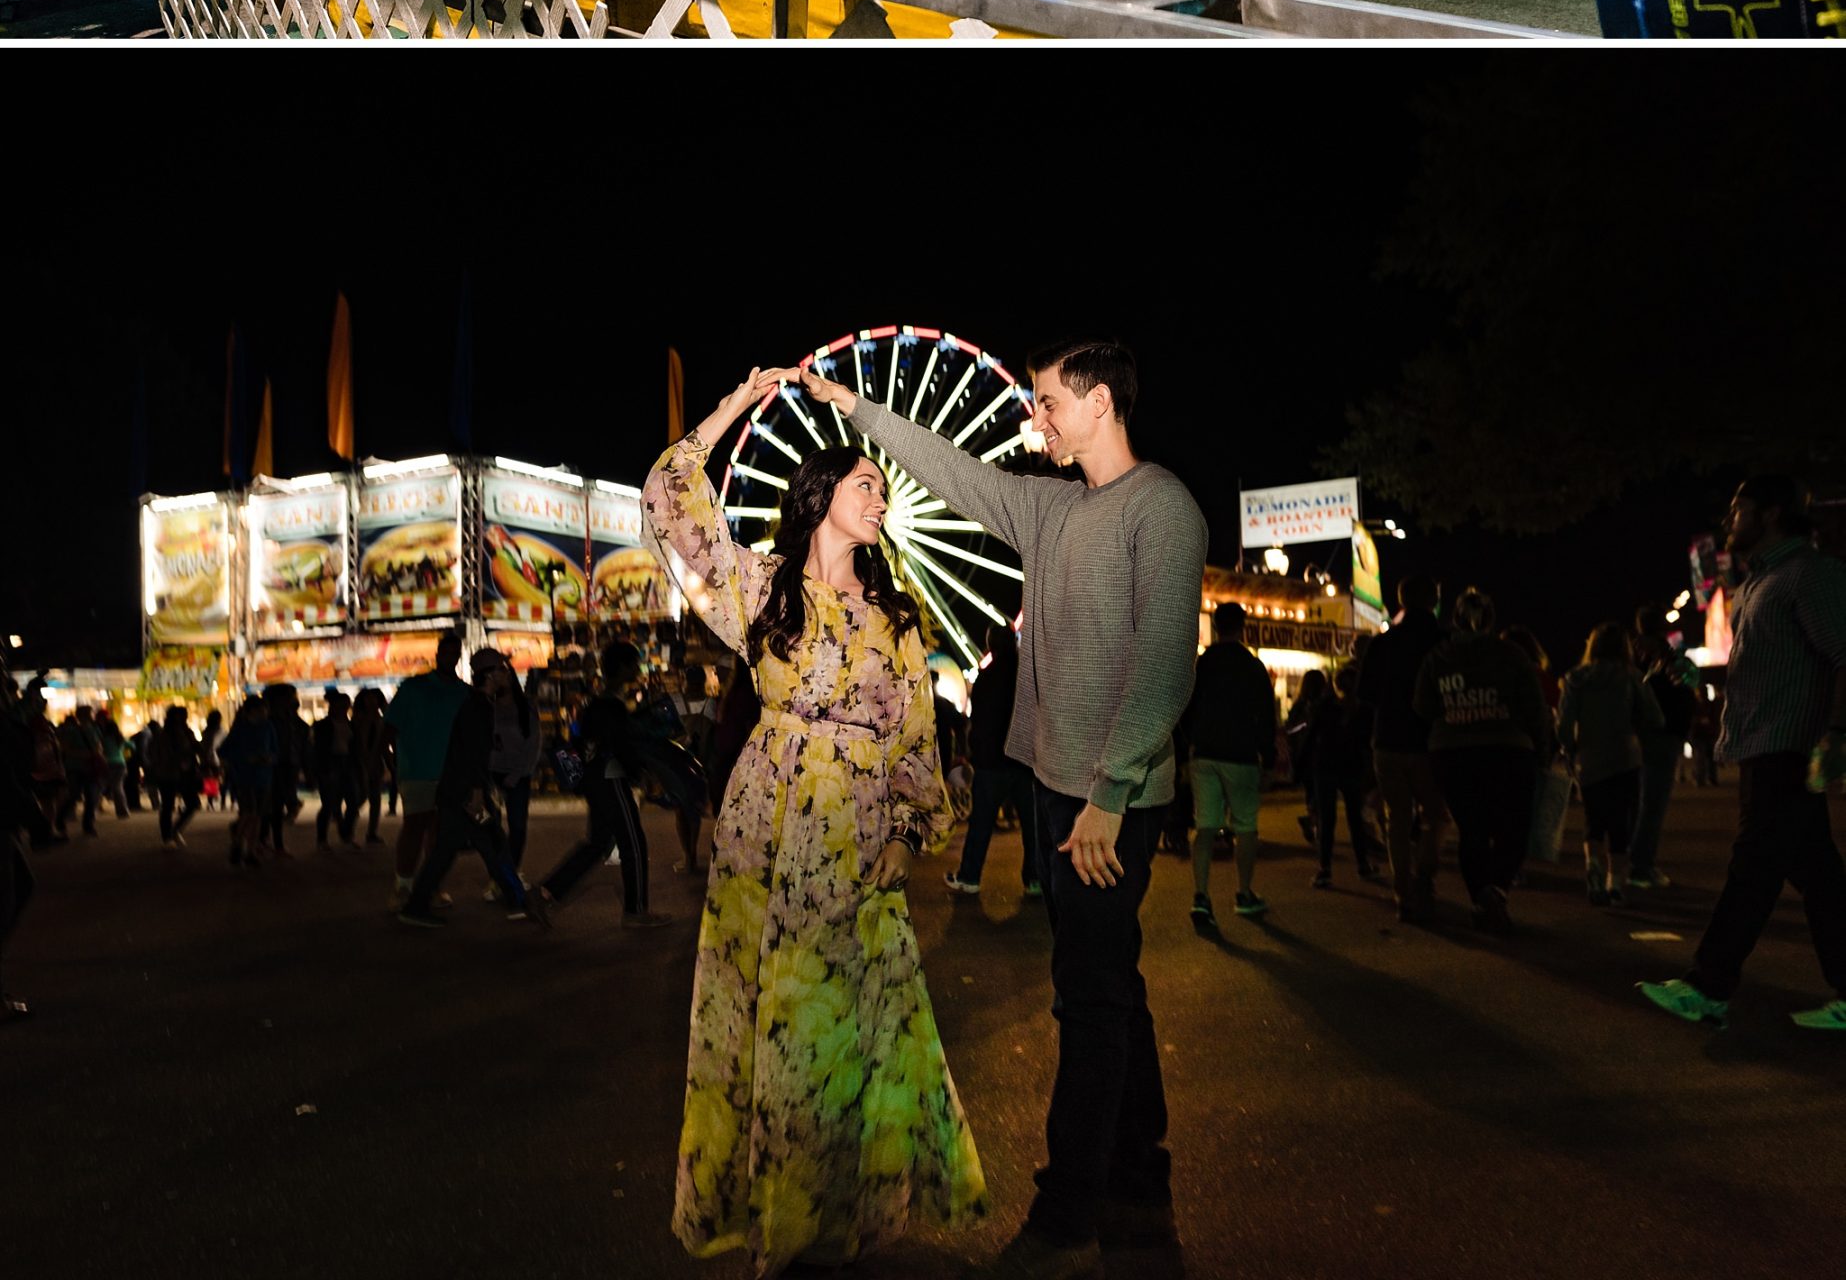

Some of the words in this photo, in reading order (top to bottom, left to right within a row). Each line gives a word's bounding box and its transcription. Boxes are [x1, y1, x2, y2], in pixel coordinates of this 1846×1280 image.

[1247, 493, 1352, 515] LEMONADE
[1248, 516, 1260, 528] &
[1266, 506, 1354, 525] ROASTED
[1272, 523, 1324, 537] CORN
[1438, 673, 1465, 694] NO
